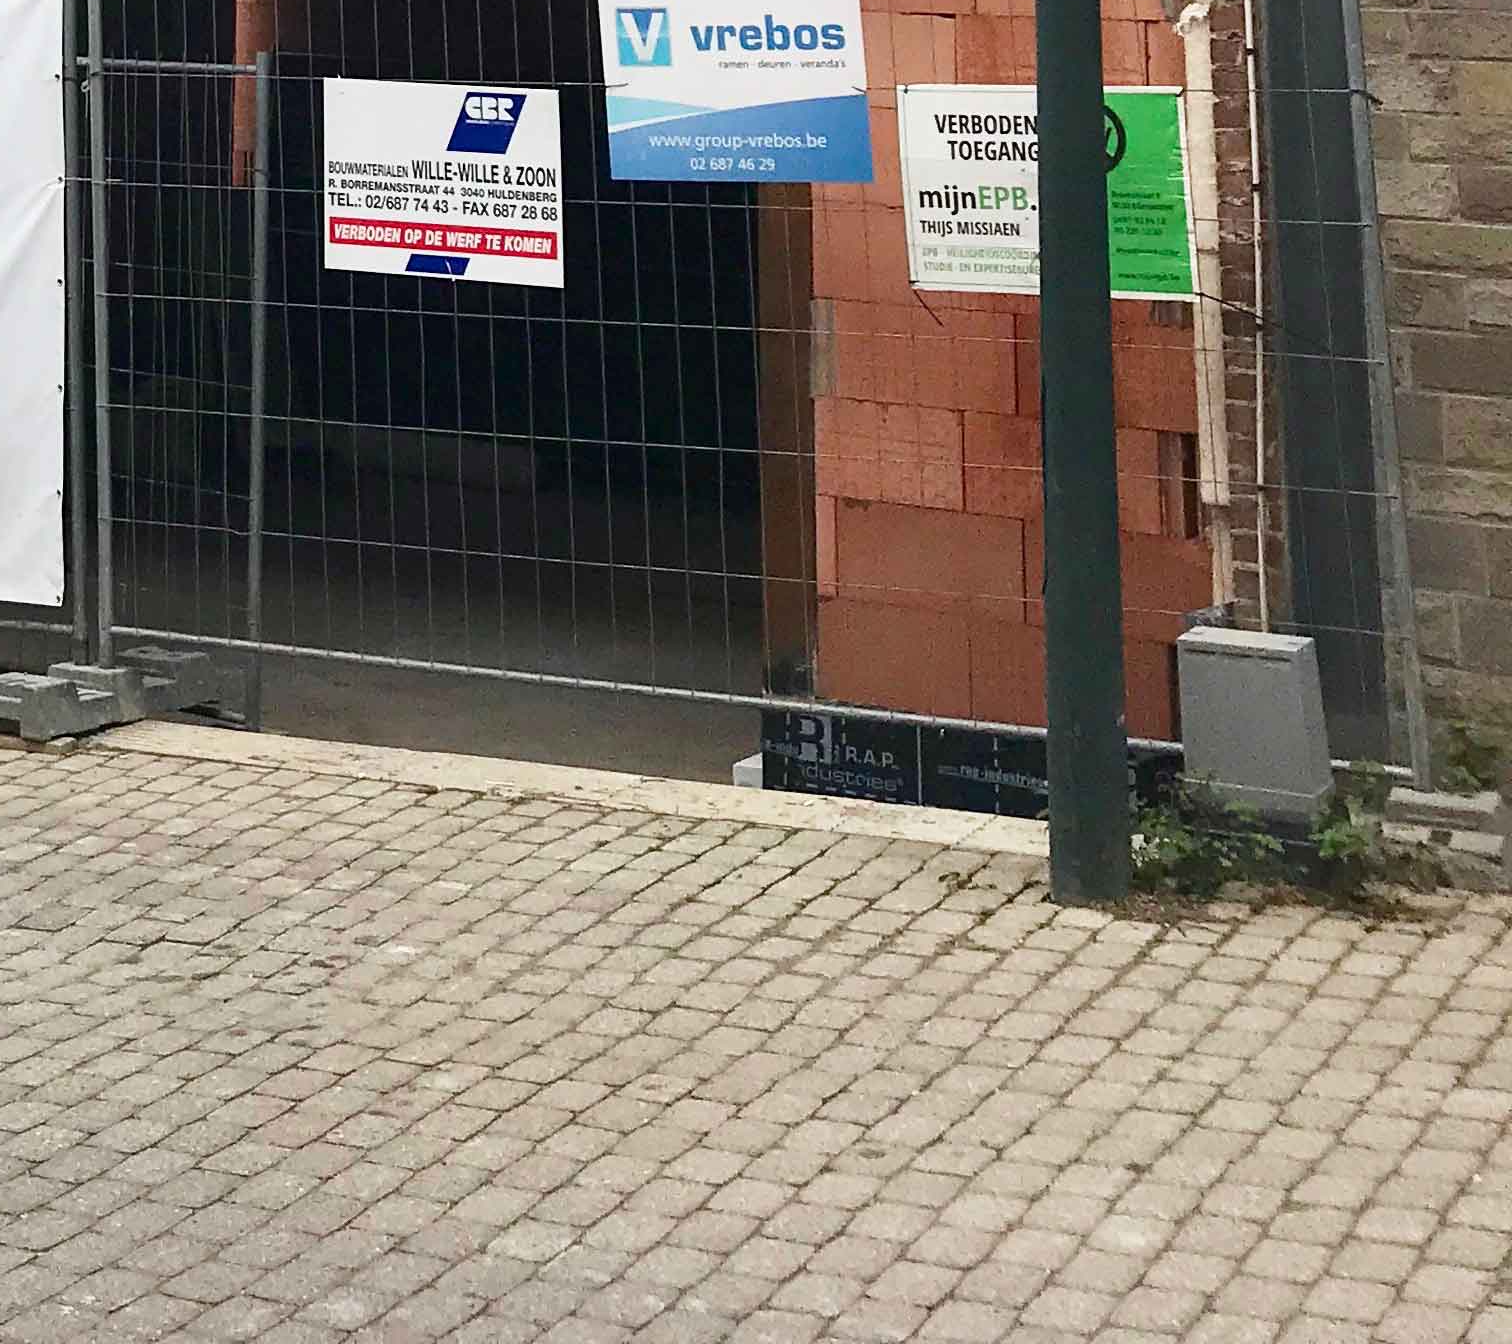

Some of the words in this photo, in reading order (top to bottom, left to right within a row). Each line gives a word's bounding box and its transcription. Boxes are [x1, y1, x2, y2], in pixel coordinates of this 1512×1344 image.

[691, 14, 846, 51] vrebos
[465, 96, 515, 121] CBR
[934, 114, 1038, 135] VERBODEN
[648, 133, 827, 151] www.group-vrebos.be
[947, 141, 1040, 161] TOEGANG
[328, 160, 409, 178] BOUWMATERIALEN
[411, 159, 499, 184] WILLE-WILLE
[503, 165, 513, 185] &
[516, 166, 556, 187] ZOON
[690, 158, 706, 170] 02
[710, 158, 733, 171] 687
[738, 158, 755, 171] 46
[759, 158, 776, 171] 29
[328, 178, 338, 188] R.
[341, 179, 441, 195] BORREMANSSTRAAT
[443, 186, 455, 195] 44
[460, 187, 486, 199] 3040
[488, 189, 558, 203] HULDENBERG
[328, 192, 362, 208] TEL.:
[365, 195, 409, 211] 02/687
[413, 198, 429, 212] 74
[432, 200, 449, 214] 43
[462, 201, 490, 217] FAX
[493, 204, 517, 218] 687
[521, 205, 538, 220] 28
[541, 207, 558, 221] 68
[334, 223, 402, 243] VERBODEN
[405, 228, 422, 244] OP
[425, 230, 444, 246] DE
[446, 231, 482, 249] WERF
[485, 234, 502, 250] TE
[504, 235, 553, 254] KOMEN
[919, 220, 954, 237] THIJS
[957, 222, 1021, 236] MISSIAEN
